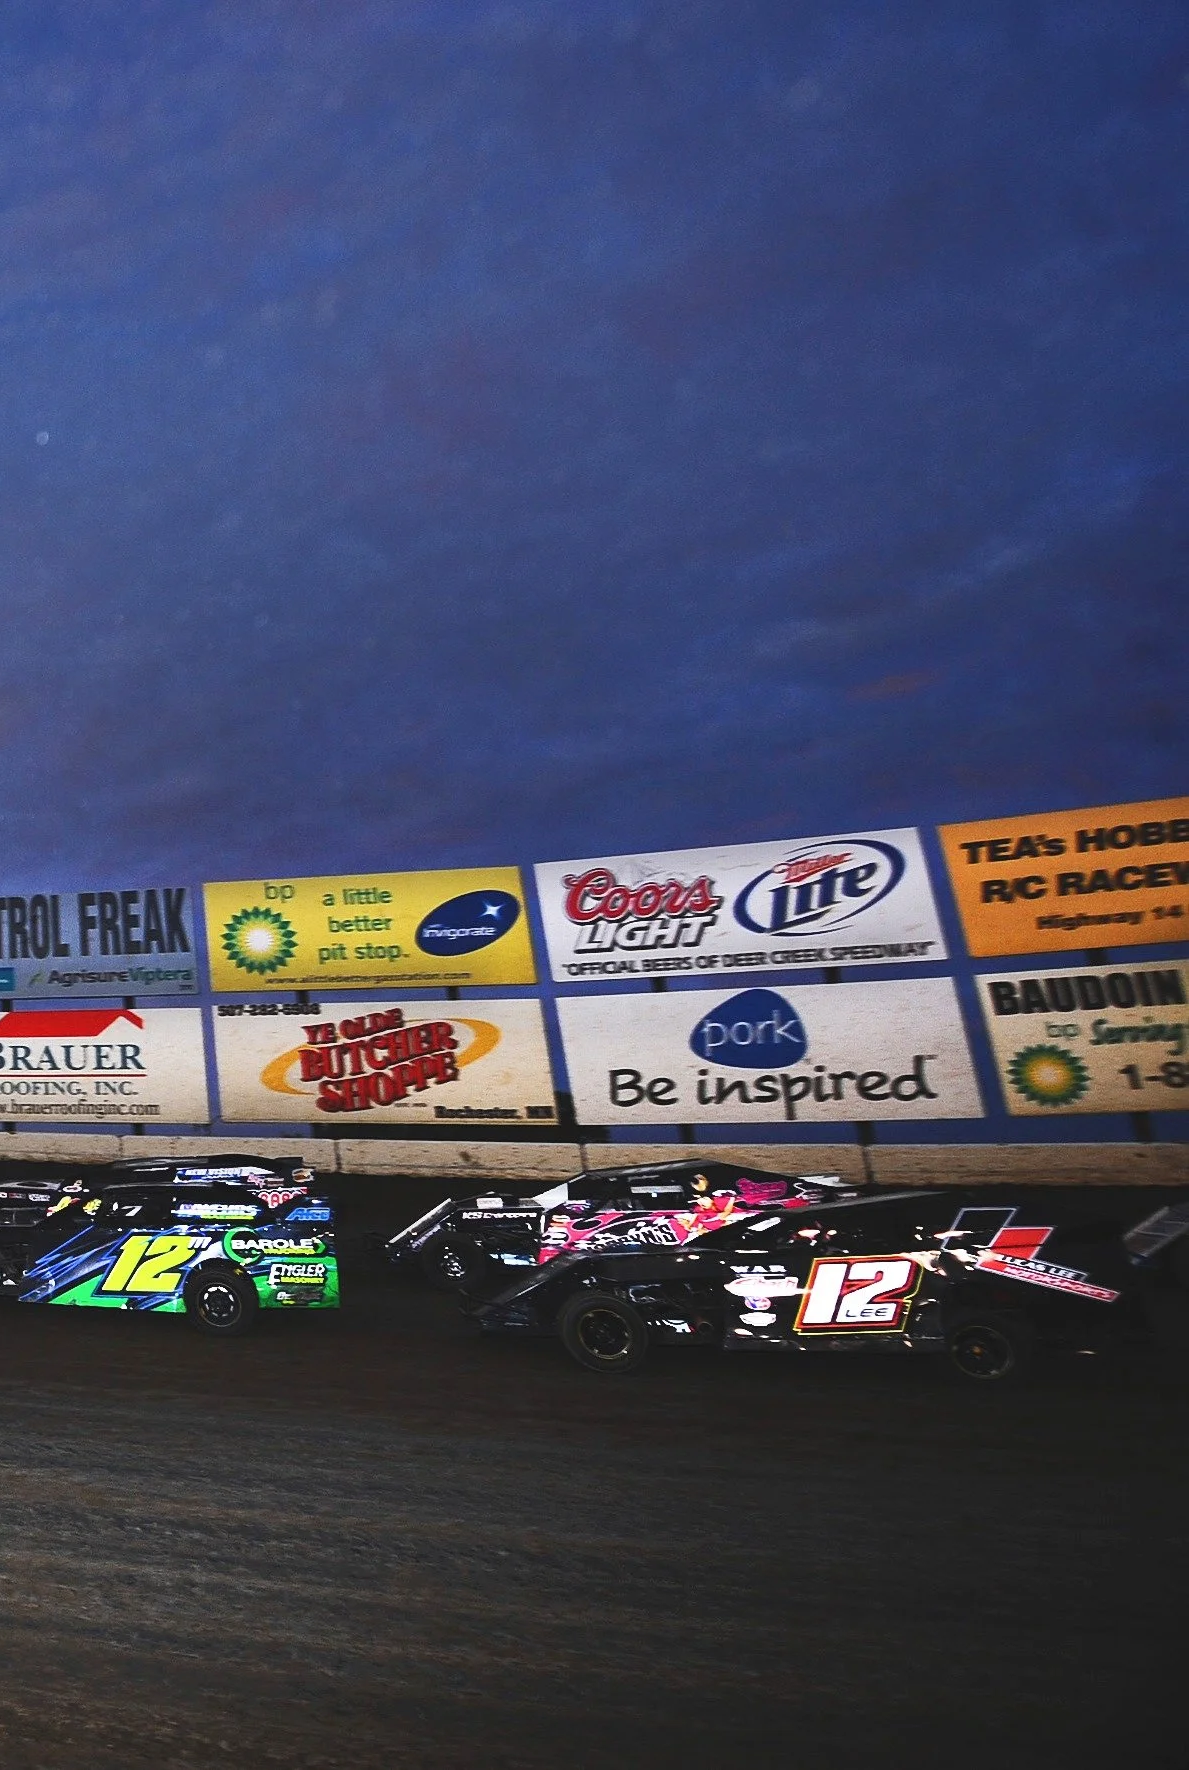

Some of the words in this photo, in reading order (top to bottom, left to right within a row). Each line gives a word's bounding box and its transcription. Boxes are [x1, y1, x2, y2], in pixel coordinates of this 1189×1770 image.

[960, 834, 1066, 864] TEA's
[265, 882, 294, 903] bp
[322, 891, 335, 906] a
[342, 888, 393, 906] little
[563, 867, 723, 924] Coors
[767, 862, 877, 934] Lite
[78, 888, 191, 957] FREAK
[328, 916, 393, 933] better
[575, 915, 717, 954] LIGHT
[318, 942, 346, 965] pit
[354, 942, 410, 963] stop.
[643, 955, 691, 974] BEERS
[697, 952, 720, 970] OF
[723, 950, 768, 968] DEER
[770, 946, 828, 966] CREEK
[301, 1023, 337, 1044] YE
[340, 1008, 405, 1040] OLDE
[702, 1009, 804, 1056] pork
[298, 1021, 460, 1082] BUTCHER
[95, 1081, 138, 1095] INC.
[315, 1052, 460, 1113] SHOPPE
[609, 1068, 677, 1107] Be
[697, 1054, 939, 1121] inspired
[102, 1234, 197, 1292] 12
[802, 1260, 911, 1324] 12
[845, 1307, 889, 1318] LEE
